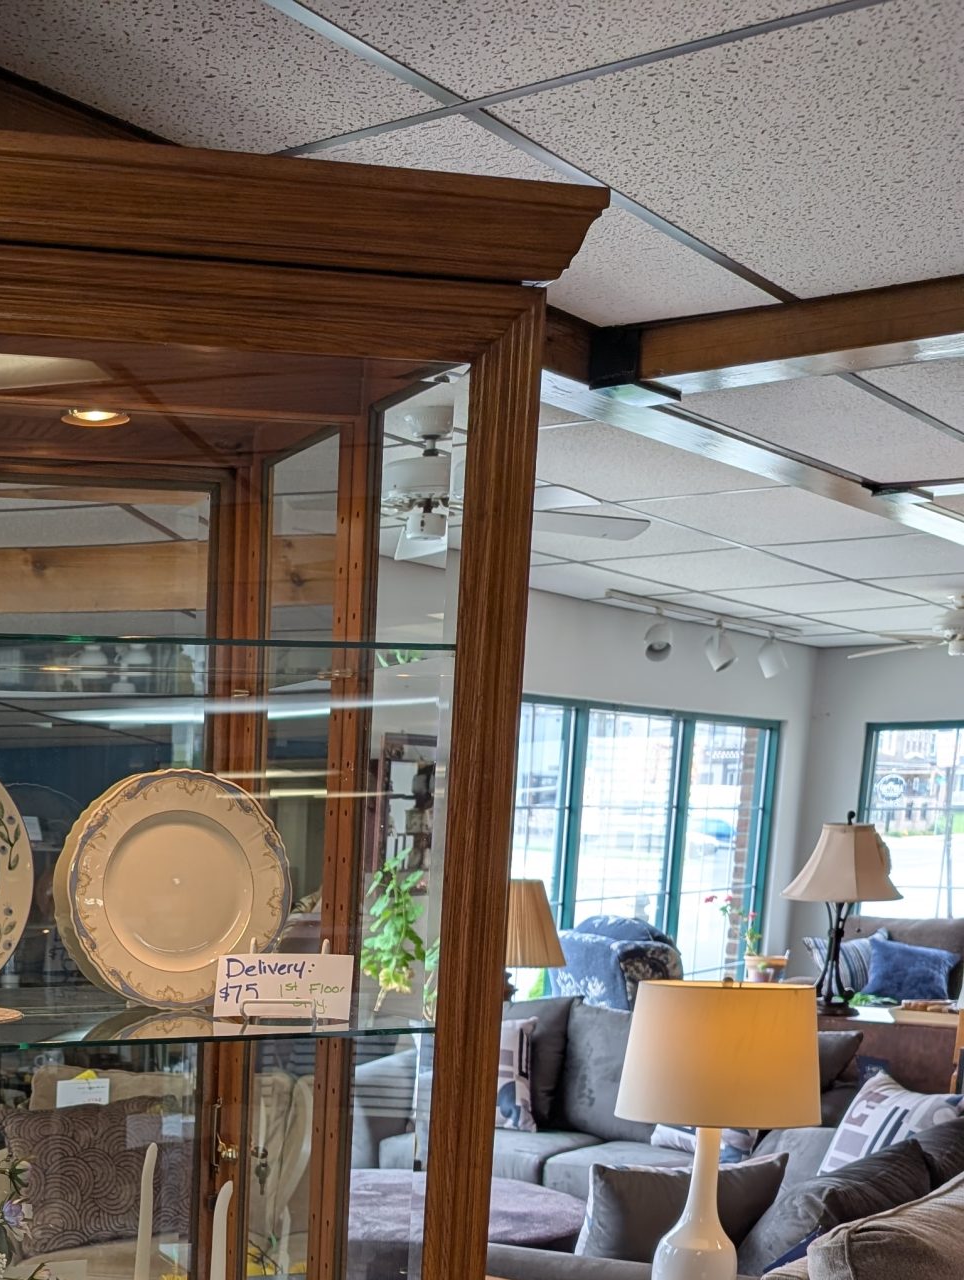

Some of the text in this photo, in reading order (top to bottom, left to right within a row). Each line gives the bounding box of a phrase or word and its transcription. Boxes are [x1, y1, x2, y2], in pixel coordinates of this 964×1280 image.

[226, 958, 315, 979] Delivery:
[219, 983, 258, 1003] $75
[309, 983, 345, 994] Floor
